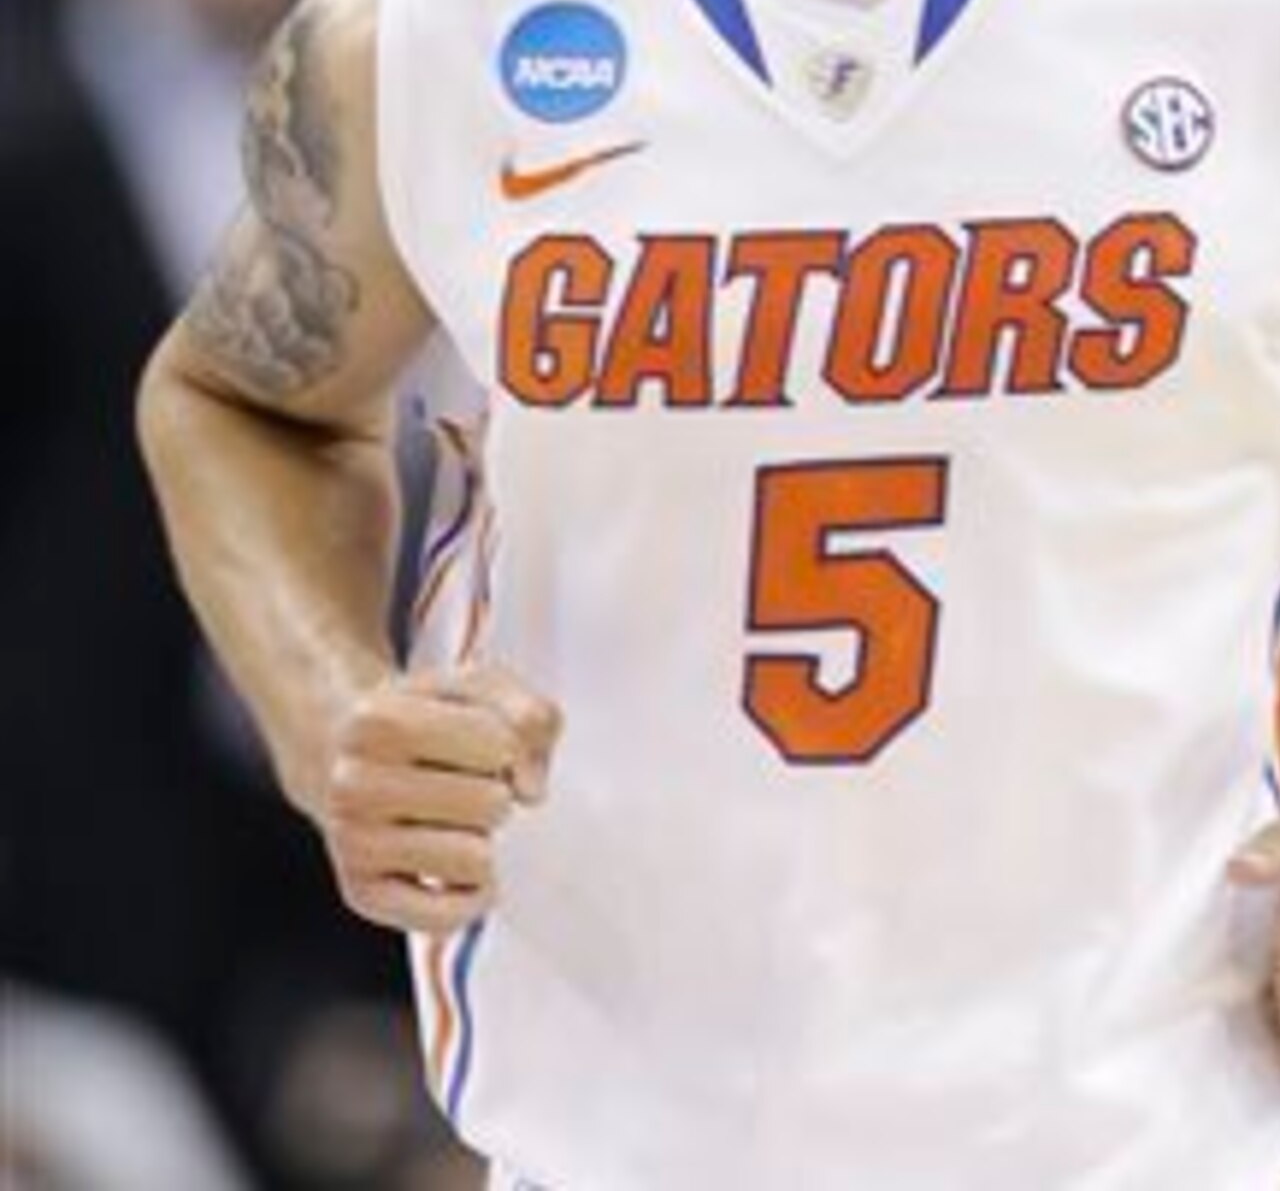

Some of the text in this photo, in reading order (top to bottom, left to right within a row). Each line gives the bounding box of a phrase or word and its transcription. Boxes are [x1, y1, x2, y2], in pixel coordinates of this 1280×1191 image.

[512, 55, 615, 90] NCAA
[1129, 87, 1207, 163] SEC
[497, 210, 1198, 410] GATORS
[741, 456, 949, 766] 5
